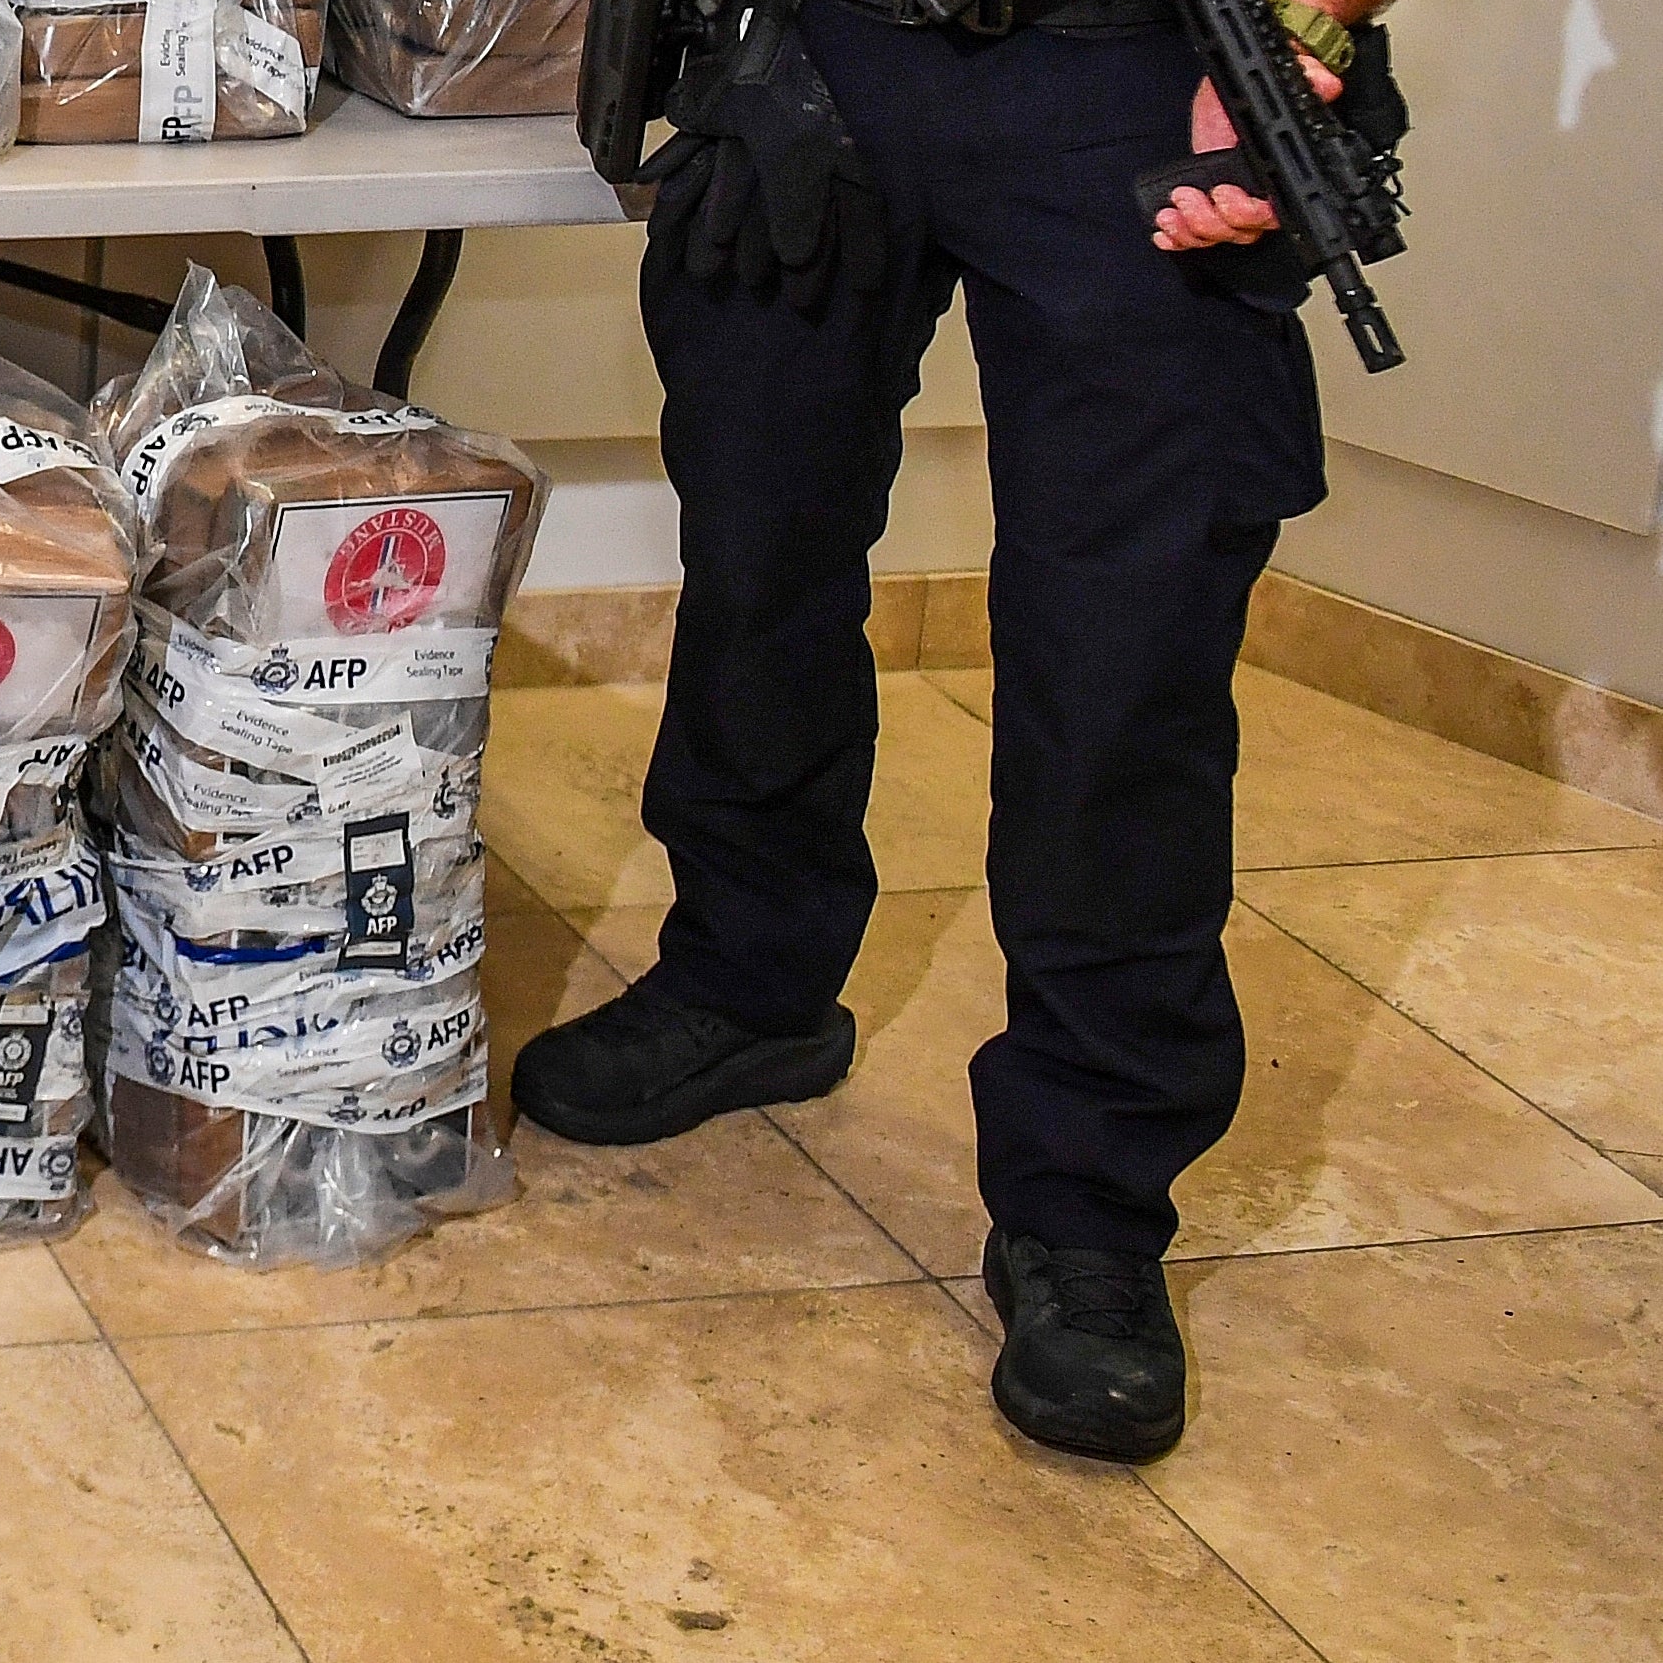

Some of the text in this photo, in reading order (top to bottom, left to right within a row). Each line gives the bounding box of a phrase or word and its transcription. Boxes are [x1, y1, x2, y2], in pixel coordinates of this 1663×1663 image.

[406, 664, 464, 680] Sealing Tape
[413, 649, 455, 662] Evidence
[145, 661, 186, 709] AFP
[303, 658, 368, 691] AFP
[219, 720, 294, 755] Sealing Tape
[236, 709, 290, 737] Evidence
[192, 783, 248, 804] Evidence
[228, 844, 295, 880] AFP
[366, 915, 399, 936] AFP
[436, 926, 484, 967] AFP
[187, 995, 251, 1029] AFP
[427, 1007, 471, 1052] AFP
[179, 1055, 232, 1095] AFP
